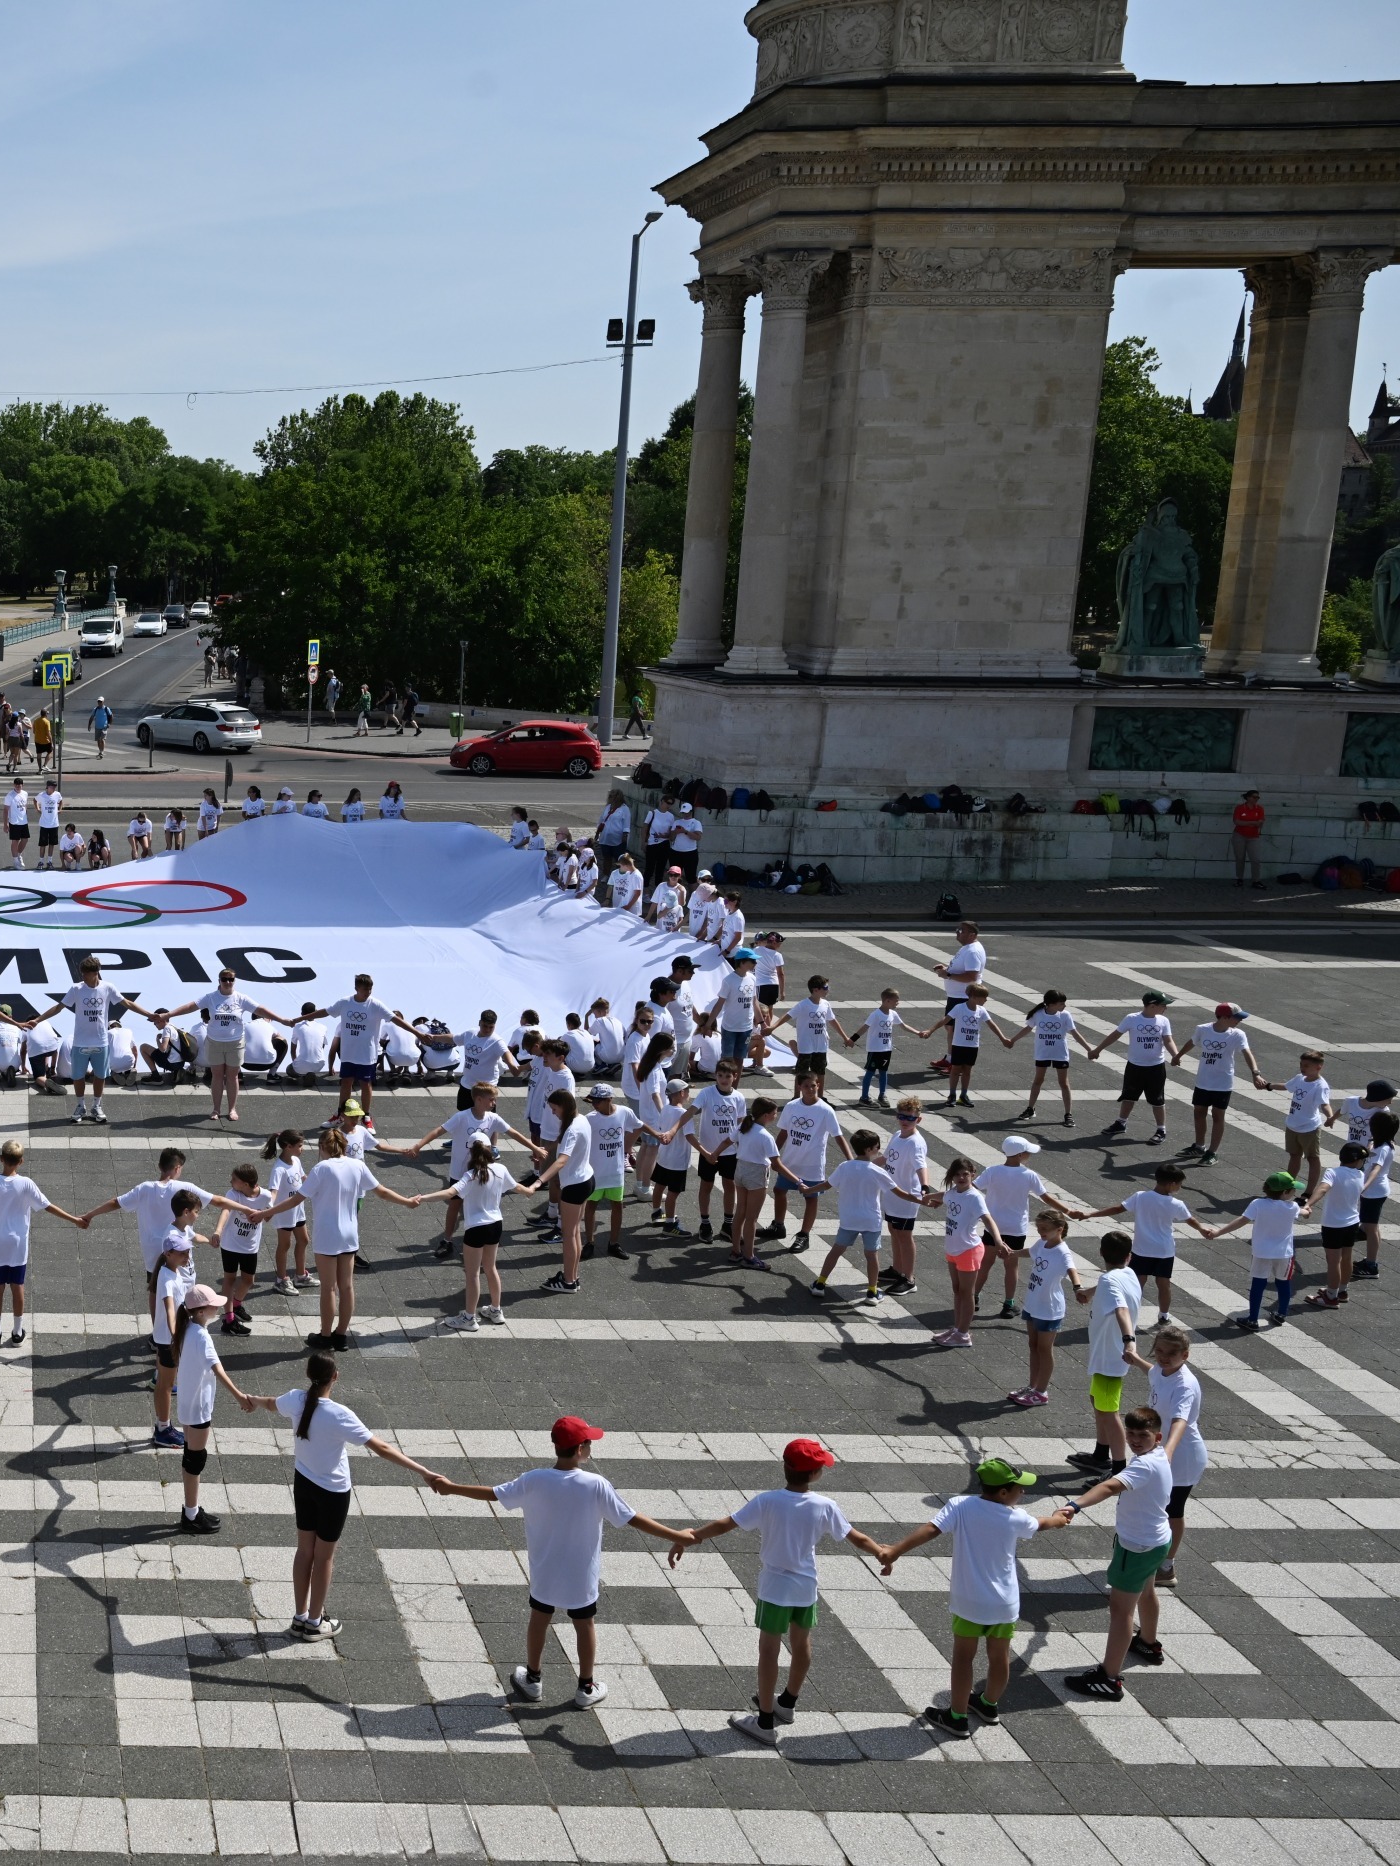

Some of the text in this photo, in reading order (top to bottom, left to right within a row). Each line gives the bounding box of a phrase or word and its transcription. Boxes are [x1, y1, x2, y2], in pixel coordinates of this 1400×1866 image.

[346, 1023, 366, 1031] OLYMPIC
[1351, 1133, 1361, 1141] DAY
[599, 1141, 622, 1151] OLYMPIC
[234, 1218, 258, 1230] OLYMPIC
[237, 1229, 249, 1237] DAY
